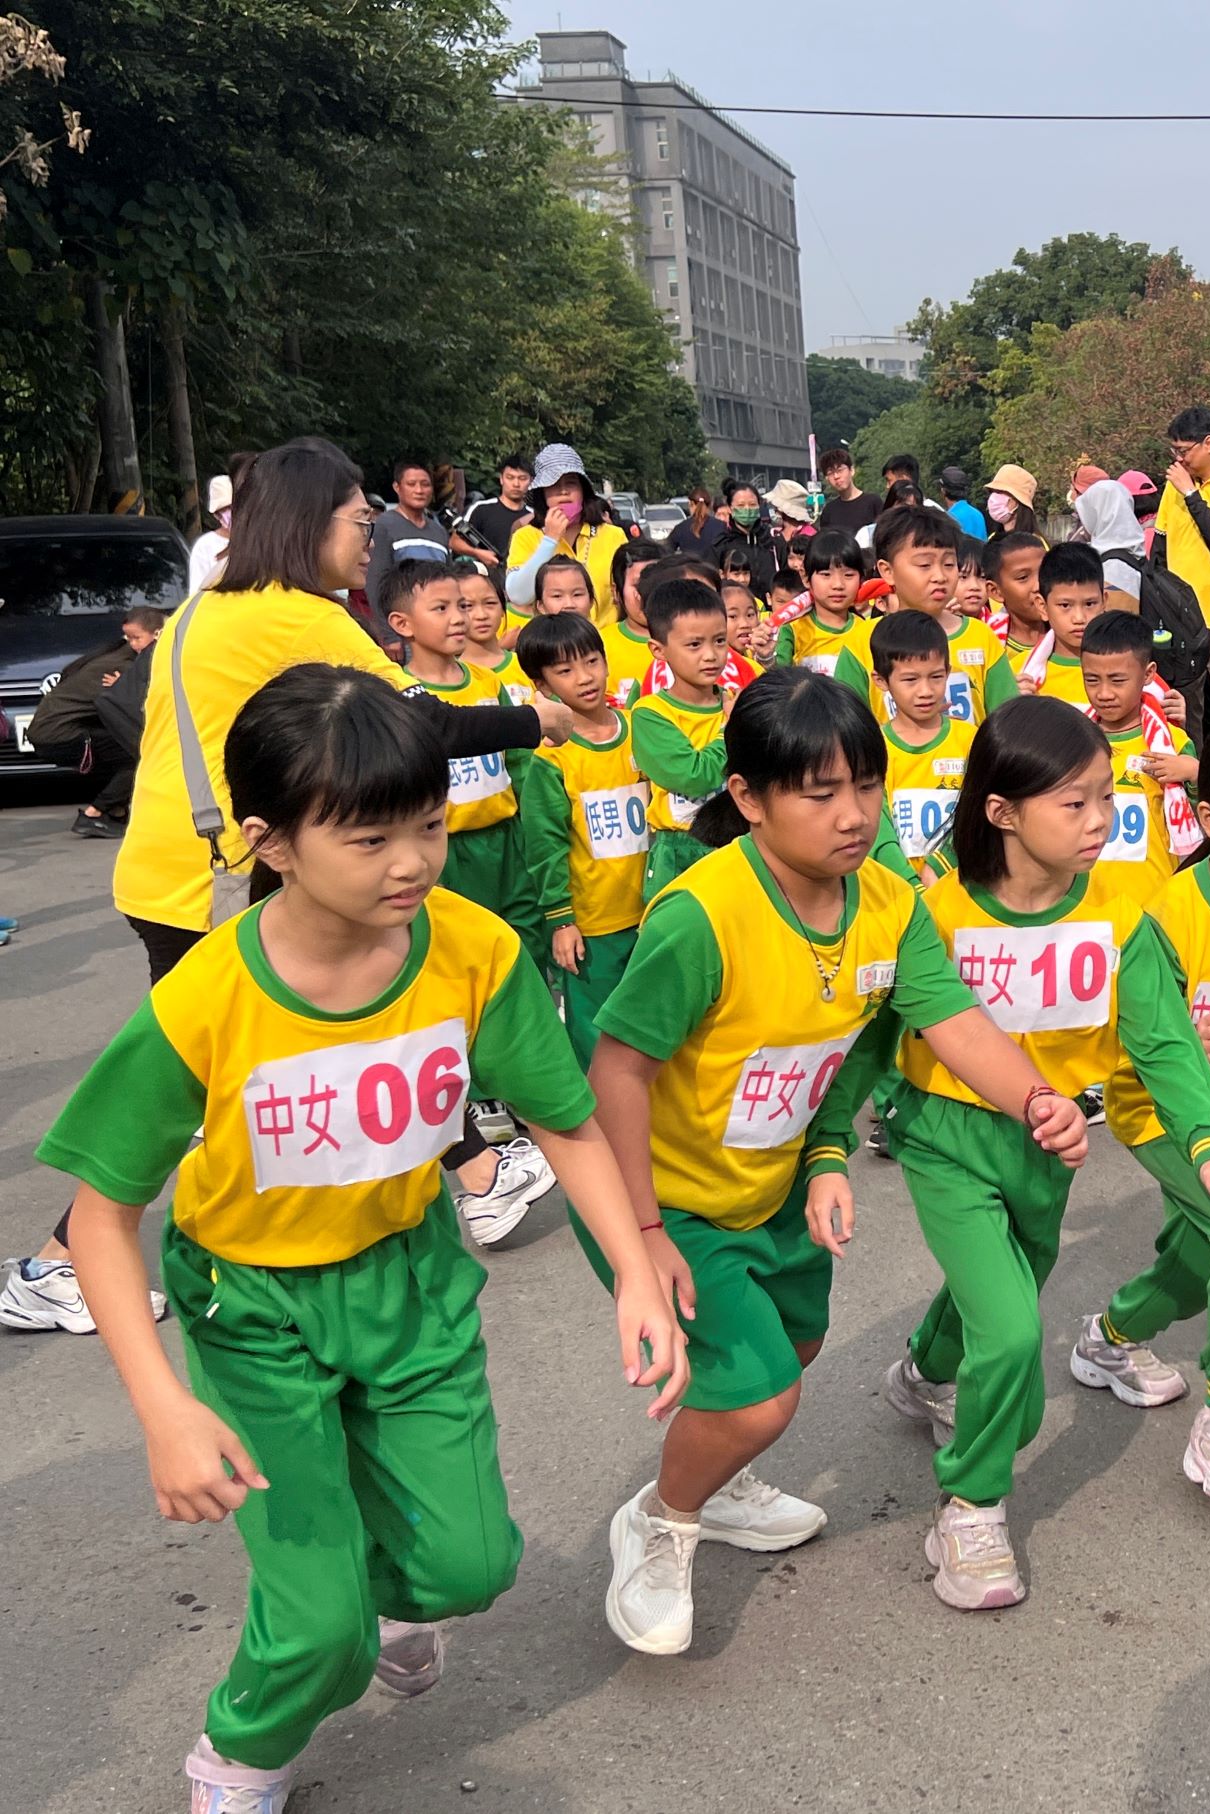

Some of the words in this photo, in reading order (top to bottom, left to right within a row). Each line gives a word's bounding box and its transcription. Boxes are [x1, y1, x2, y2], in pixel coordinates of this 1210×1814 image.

[943, 683, 970, 721] 5
[585, 800, 622, 842] 低男
[893, 800, 914, 839] 男
[960, 943, 1017, 1007] 中女
[1031, 941, 1107, 1008] 10
[255, 1074, 341, 1156] 中女
[356, 1046, 464, 1145] 06
[742, 1061, 806, 1121] 中女
